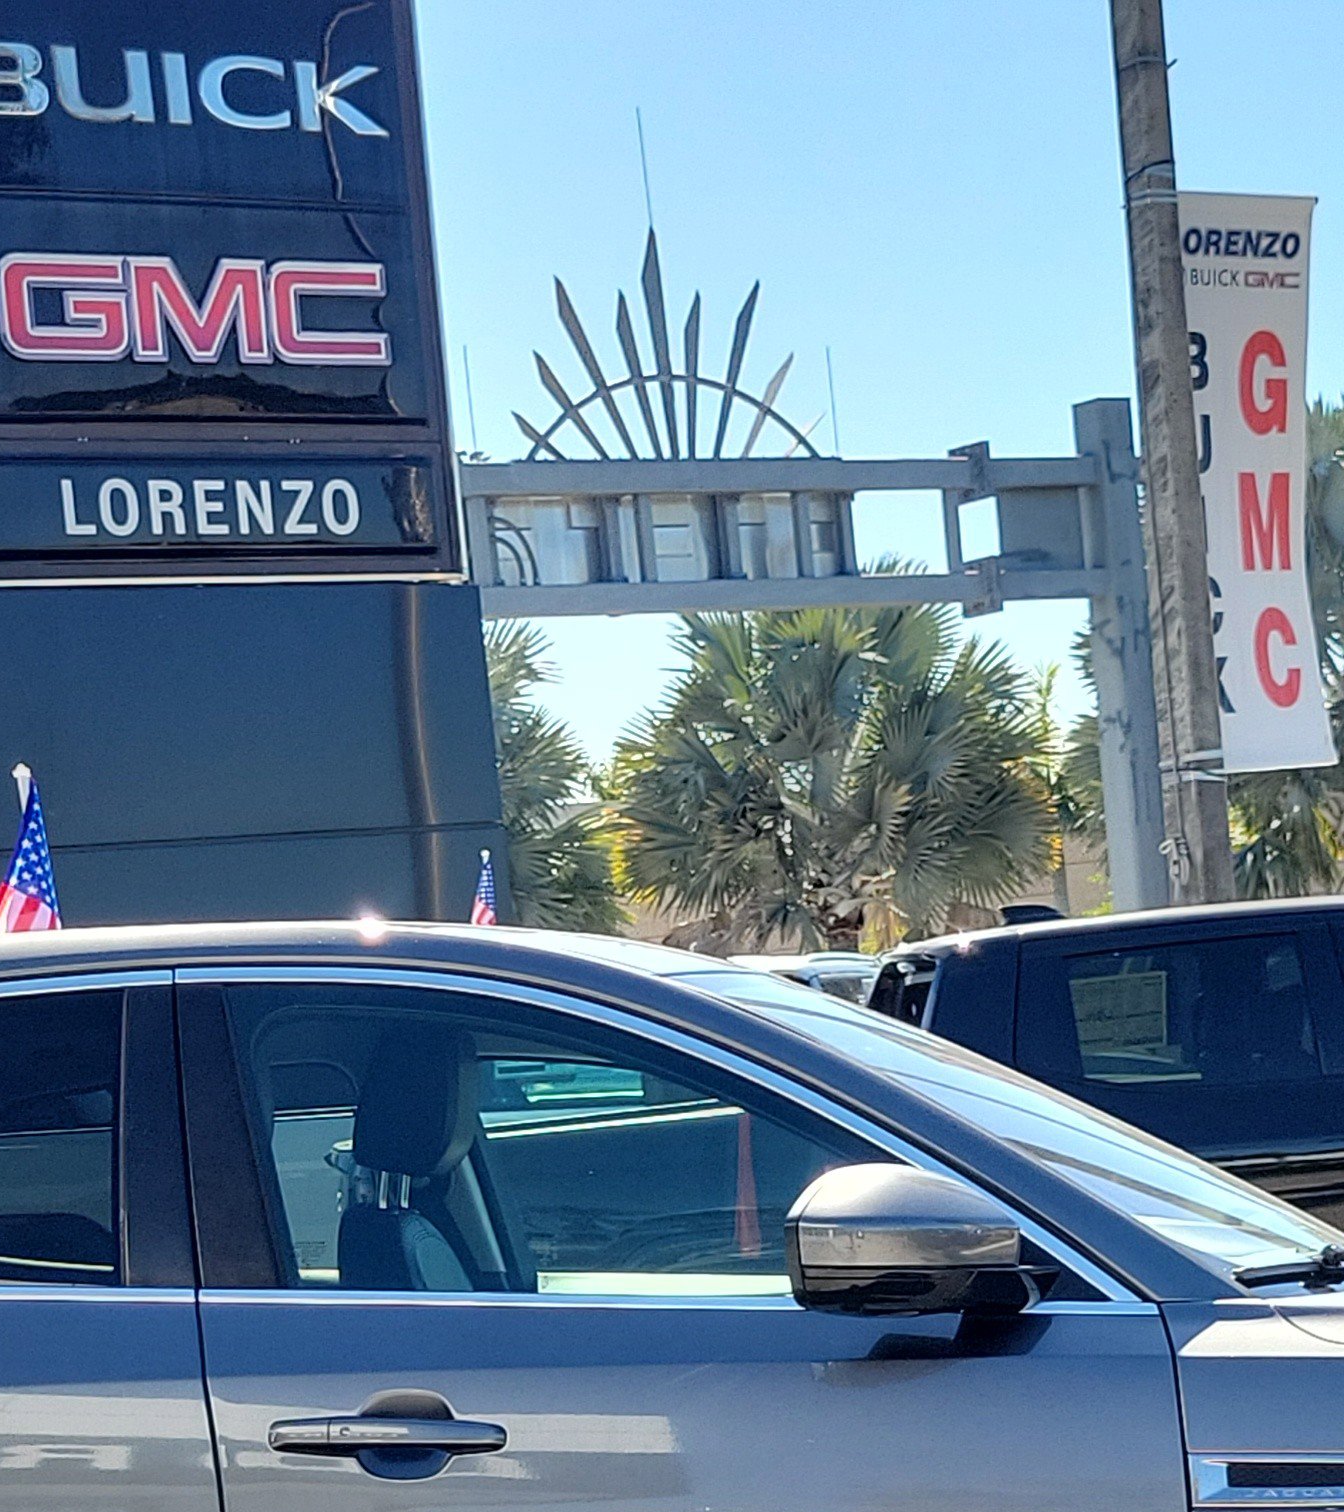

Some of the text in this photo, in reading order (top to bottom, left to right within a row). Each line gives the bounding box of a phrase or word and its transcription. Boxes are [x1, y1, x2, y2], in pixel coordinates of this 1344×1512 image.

[1182, 228, 1301, 259] ORENZO
[1190, 268, 1300, 289] BUICK GMC
[60, 477, 359, 537] LORENZO
[1238, 330, 1300, 707] GMC
